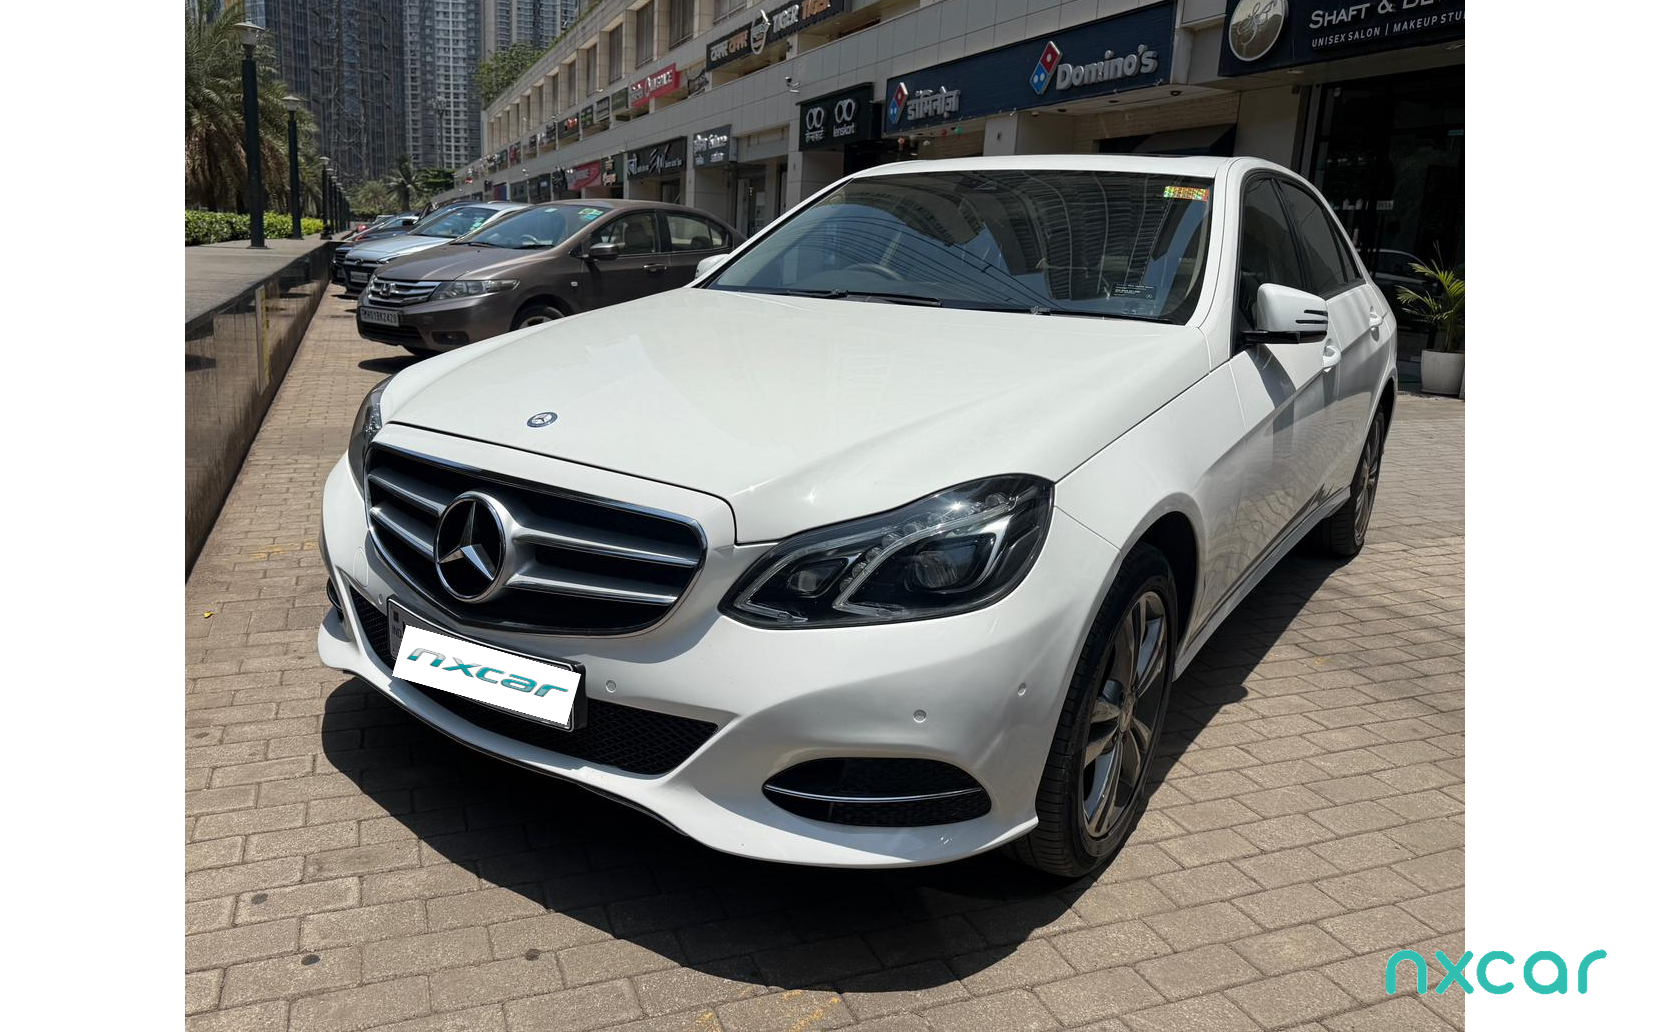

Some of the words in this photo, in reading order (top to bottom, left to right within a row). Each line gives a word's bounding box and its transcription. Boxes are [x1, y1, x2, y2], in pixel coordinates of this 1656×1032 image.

[1308, 5, 1367, 29] SHAFT
[1312, 33, 1346, 48] UNISEX
[1348, 26, 1381, 41] SALON
[1393, 16, 1438, 33] MAKEUP
[1055, 44, 1159, 91] Domino's
